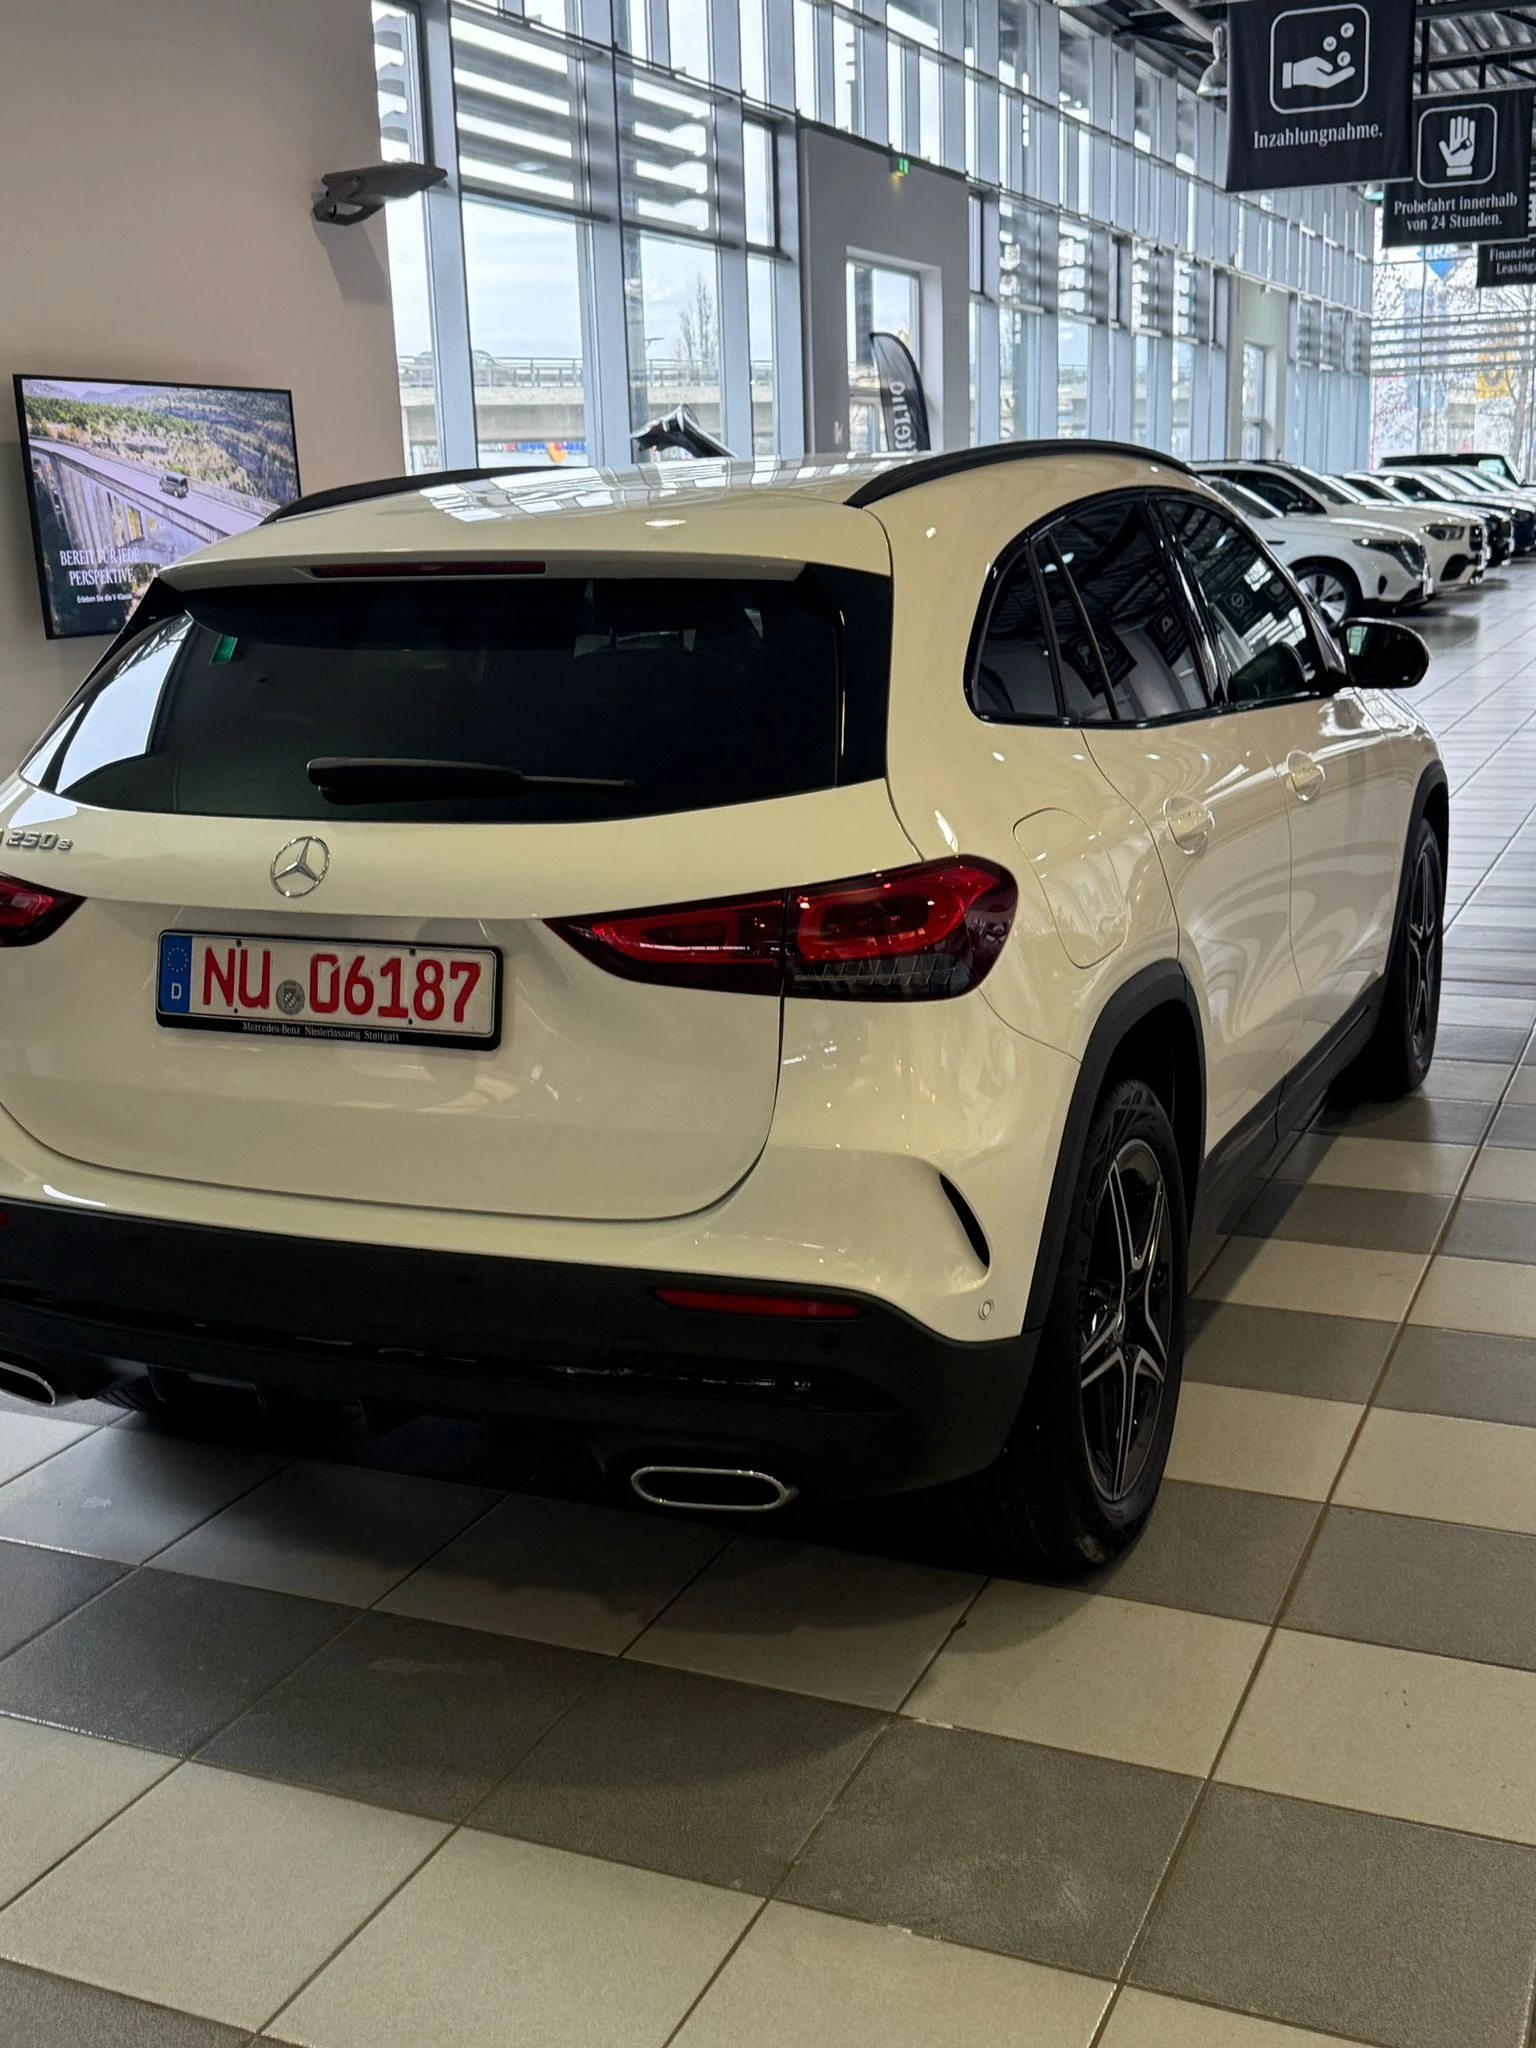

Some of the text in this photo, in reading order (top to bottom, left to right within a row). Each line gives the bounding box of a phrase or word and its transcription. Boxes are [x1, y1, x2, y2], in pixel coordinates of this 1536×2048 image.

[1253, 121, 1384, 150] Inzahlungnahme.
[1394, 194, 1518, 216] Probefahrt innerhalb
[1407, 213, 1502, 231] von 24 Stunden.
[59, 547, 140, 566] BEREIT FÜR JEDE
[96, 594, 104, 602] Sie
[171, 983, 182, 1000] D
[202, 945, 481, 1023] NU 06187
[242, 1021, 400, 1043] Mercedes-Benz Niederlassung Stuttgart
